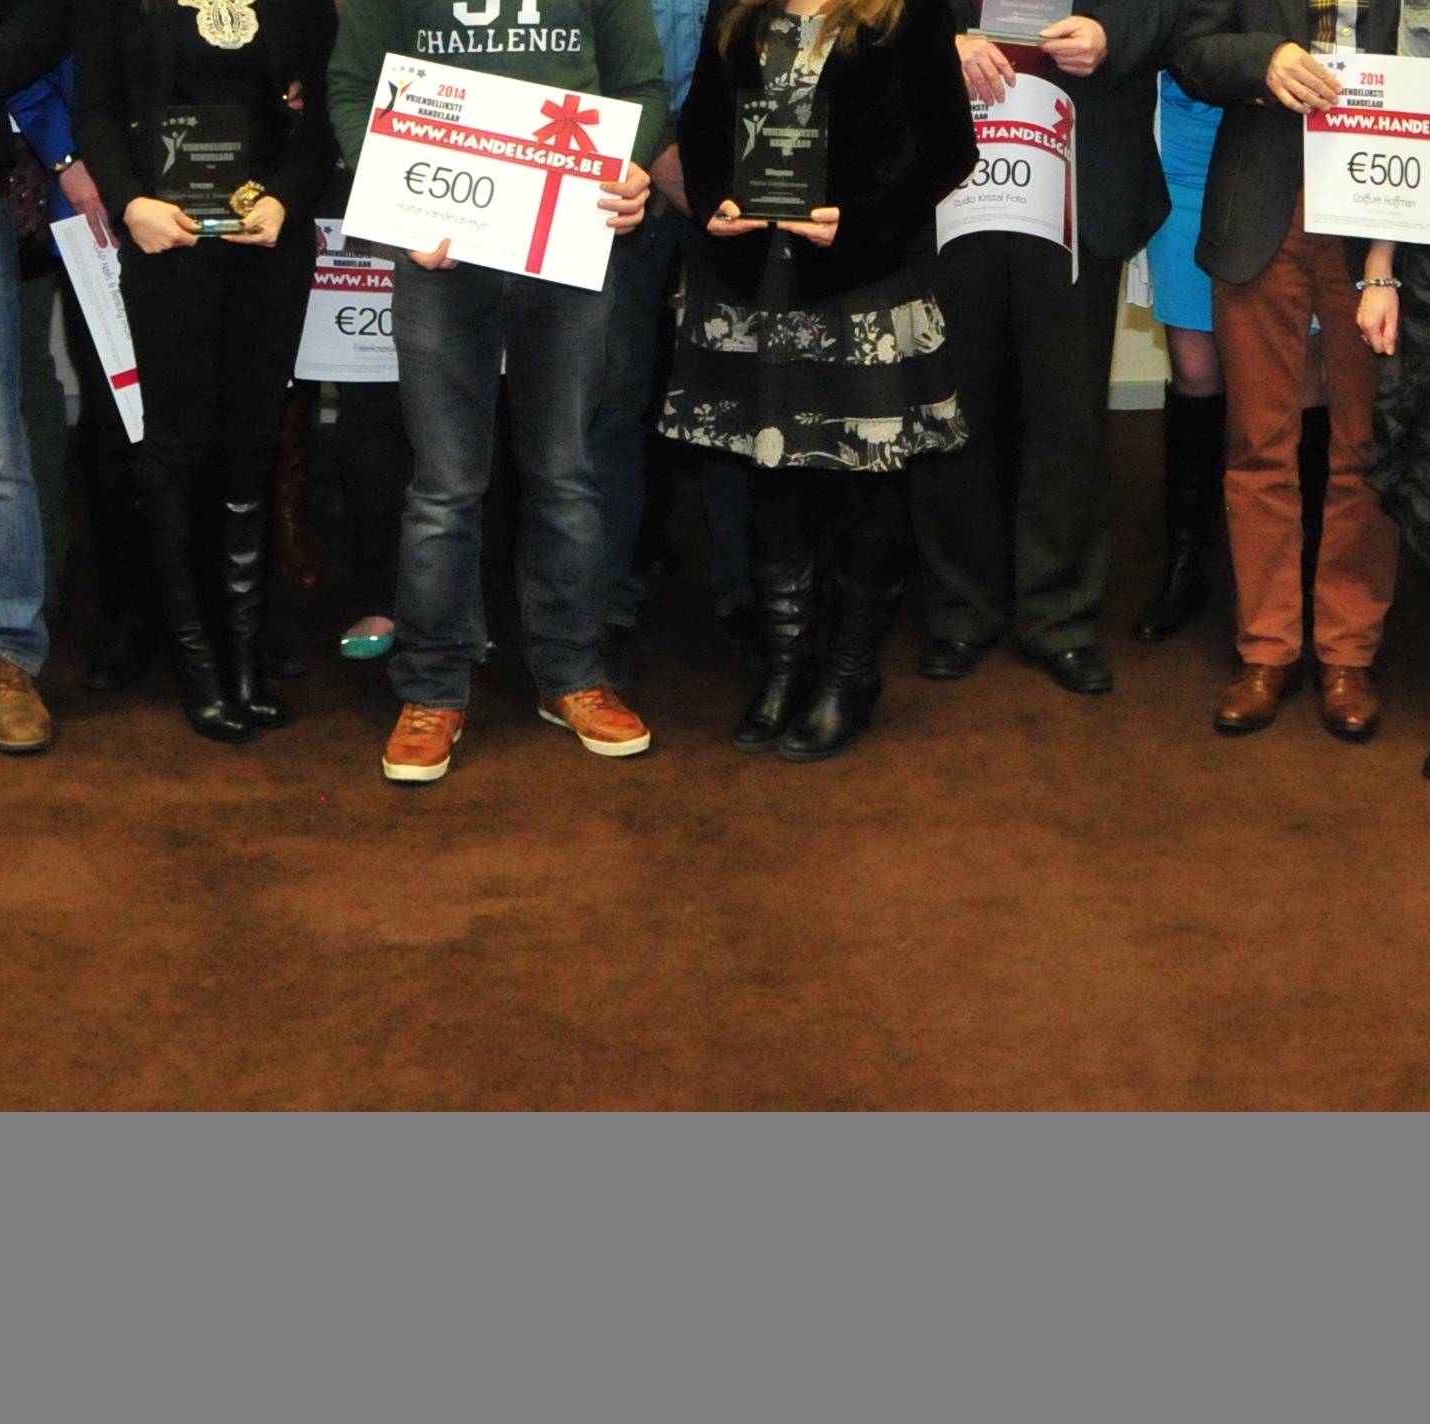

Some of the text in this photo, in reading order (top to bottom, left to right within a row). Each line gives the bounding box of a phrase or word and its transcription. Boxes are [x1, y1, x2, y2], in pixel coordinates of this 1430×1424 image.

[417, 28, 581, 54] CHALLENGE
[436, 83, 467, 101] 2014
[1360, 72, 1384, 86] 2014
[391, 117, 603, 176] WWW.HANDELSGIDS.BE
[403, 161, 495, 209] €500
[956, 158, 1031, 189] 300
[1347, 151, 1421, 189] €500
